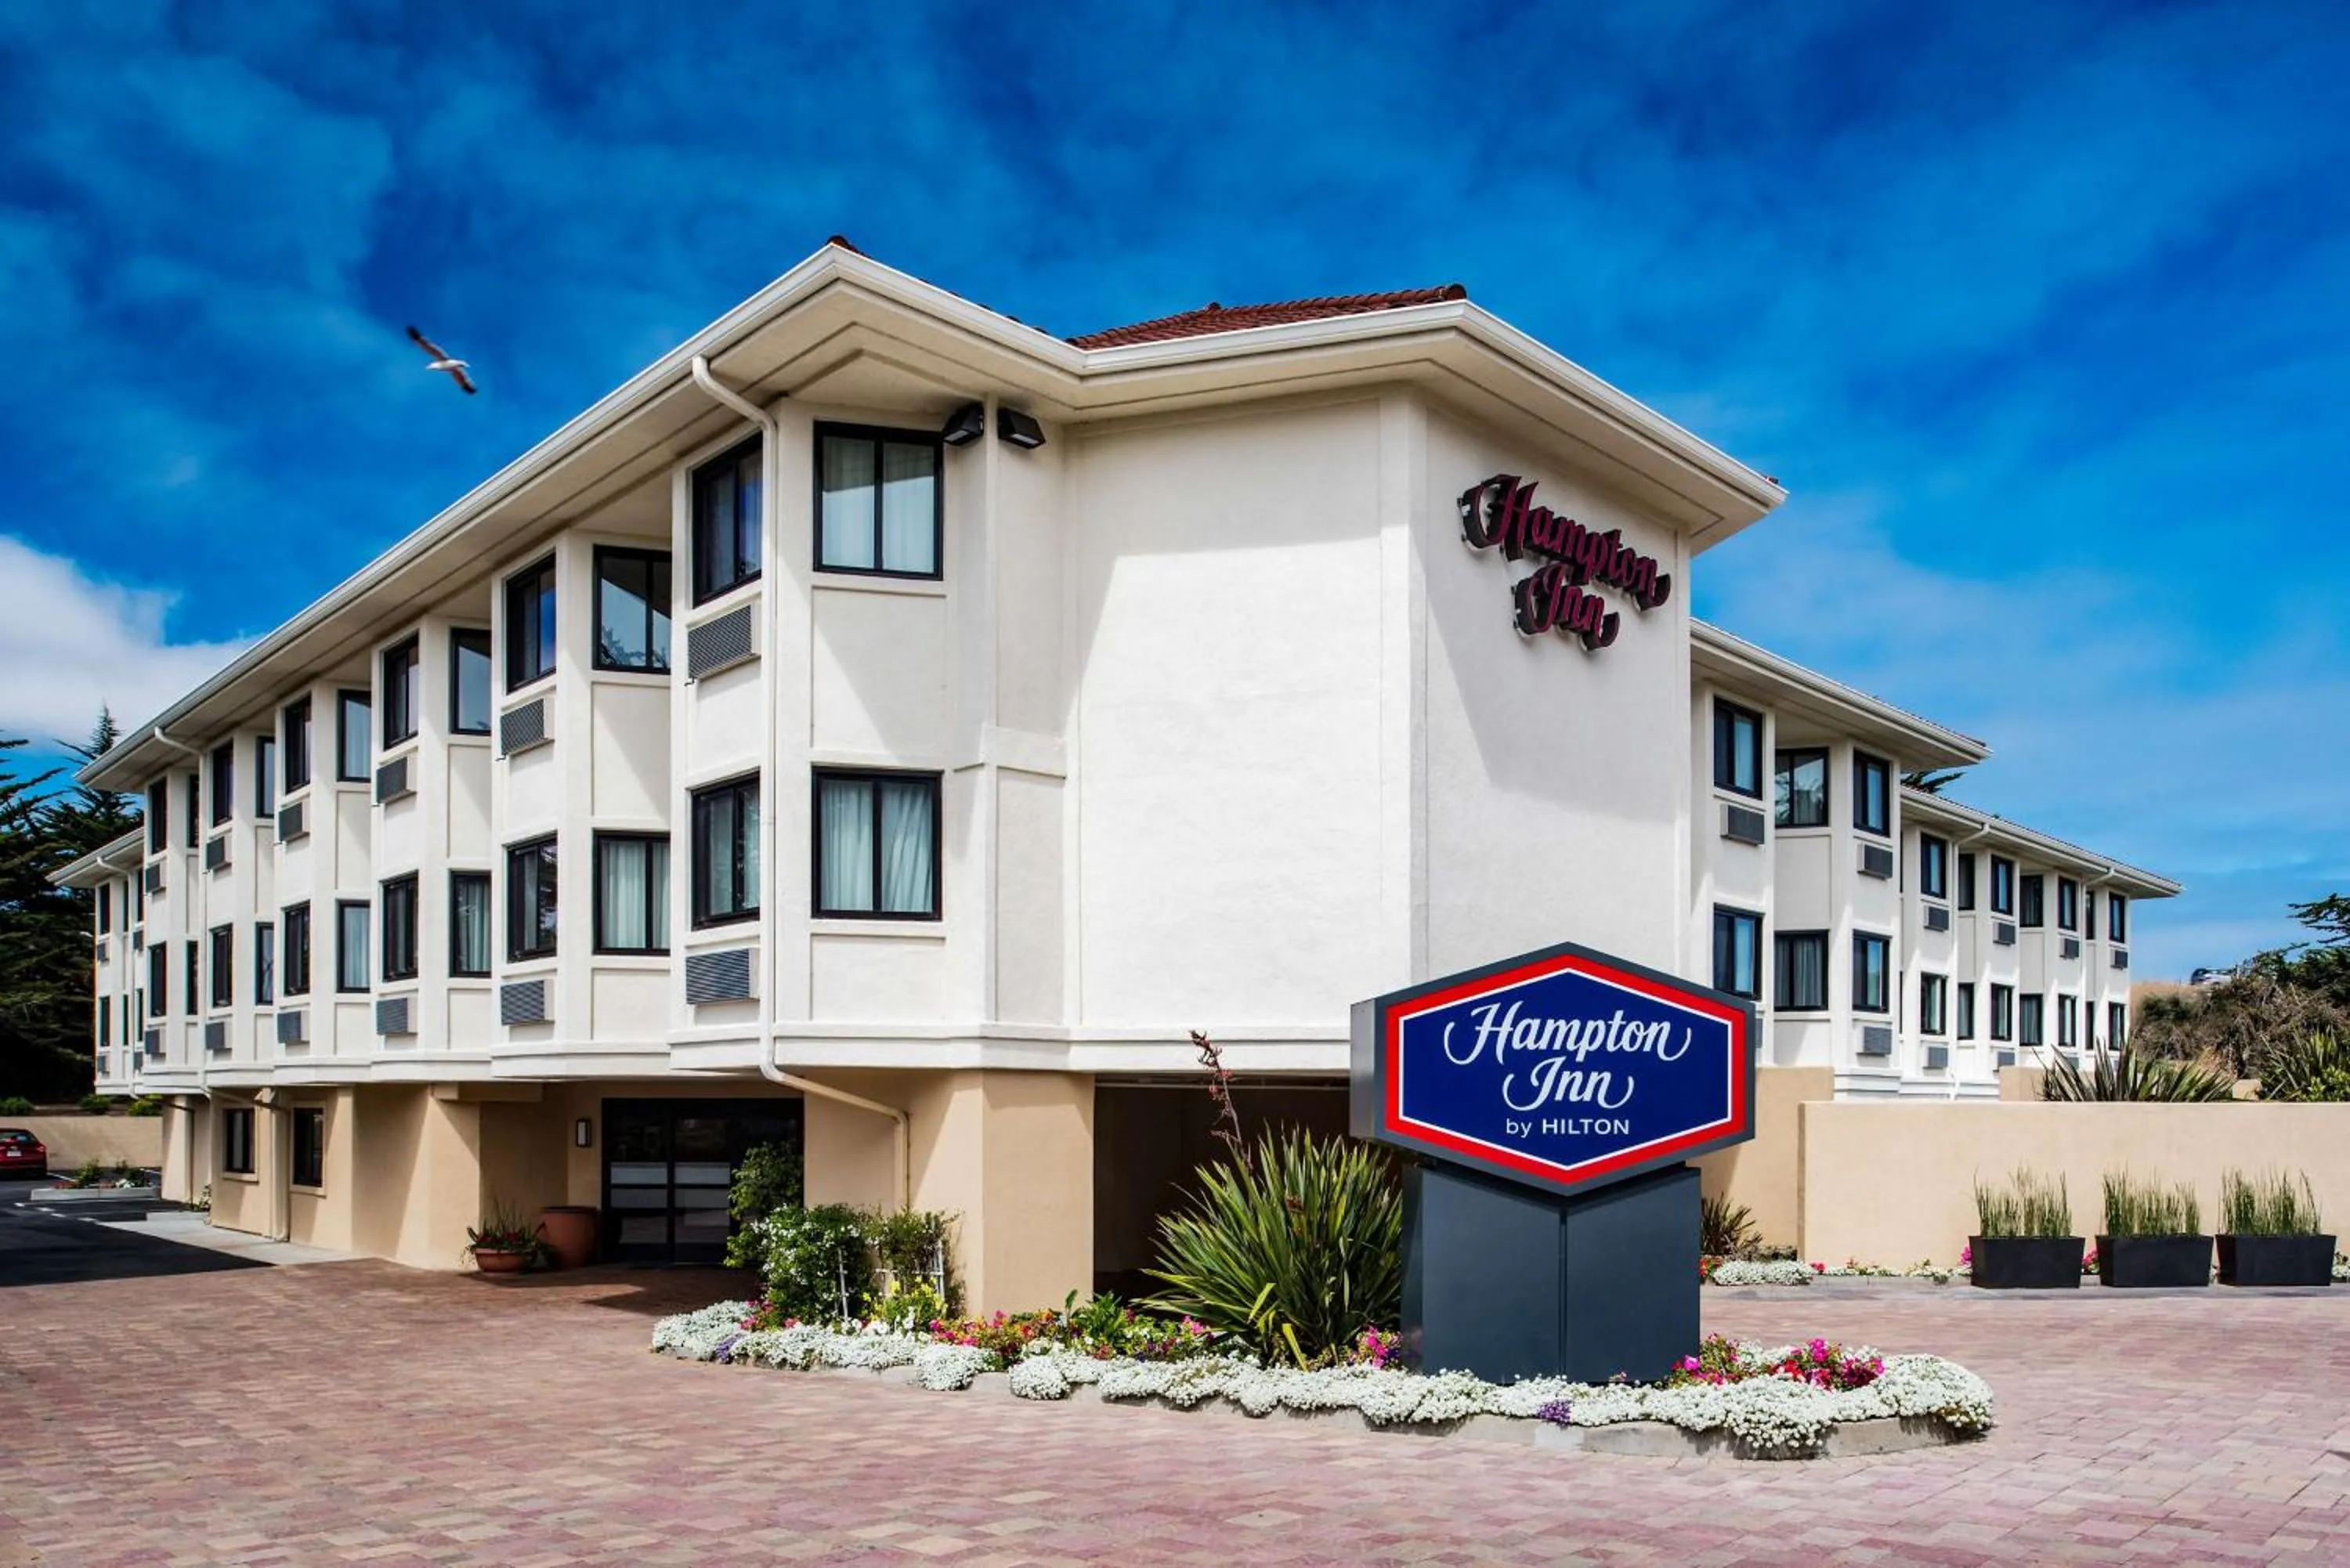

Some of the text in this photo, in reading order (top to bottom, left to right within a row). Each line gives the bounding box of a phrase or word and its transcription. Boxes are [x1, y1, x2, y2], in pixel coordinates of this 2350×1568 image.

[1460, 474, 1671, 612] Hampton
[1513, 561, 1620, 651] Inn
[1444, 1000, 1692, 1065] Hampton
[1502, 1057, 1634, 1111] Inn
[1506, 1118, 1629, 1138] by HILTON
